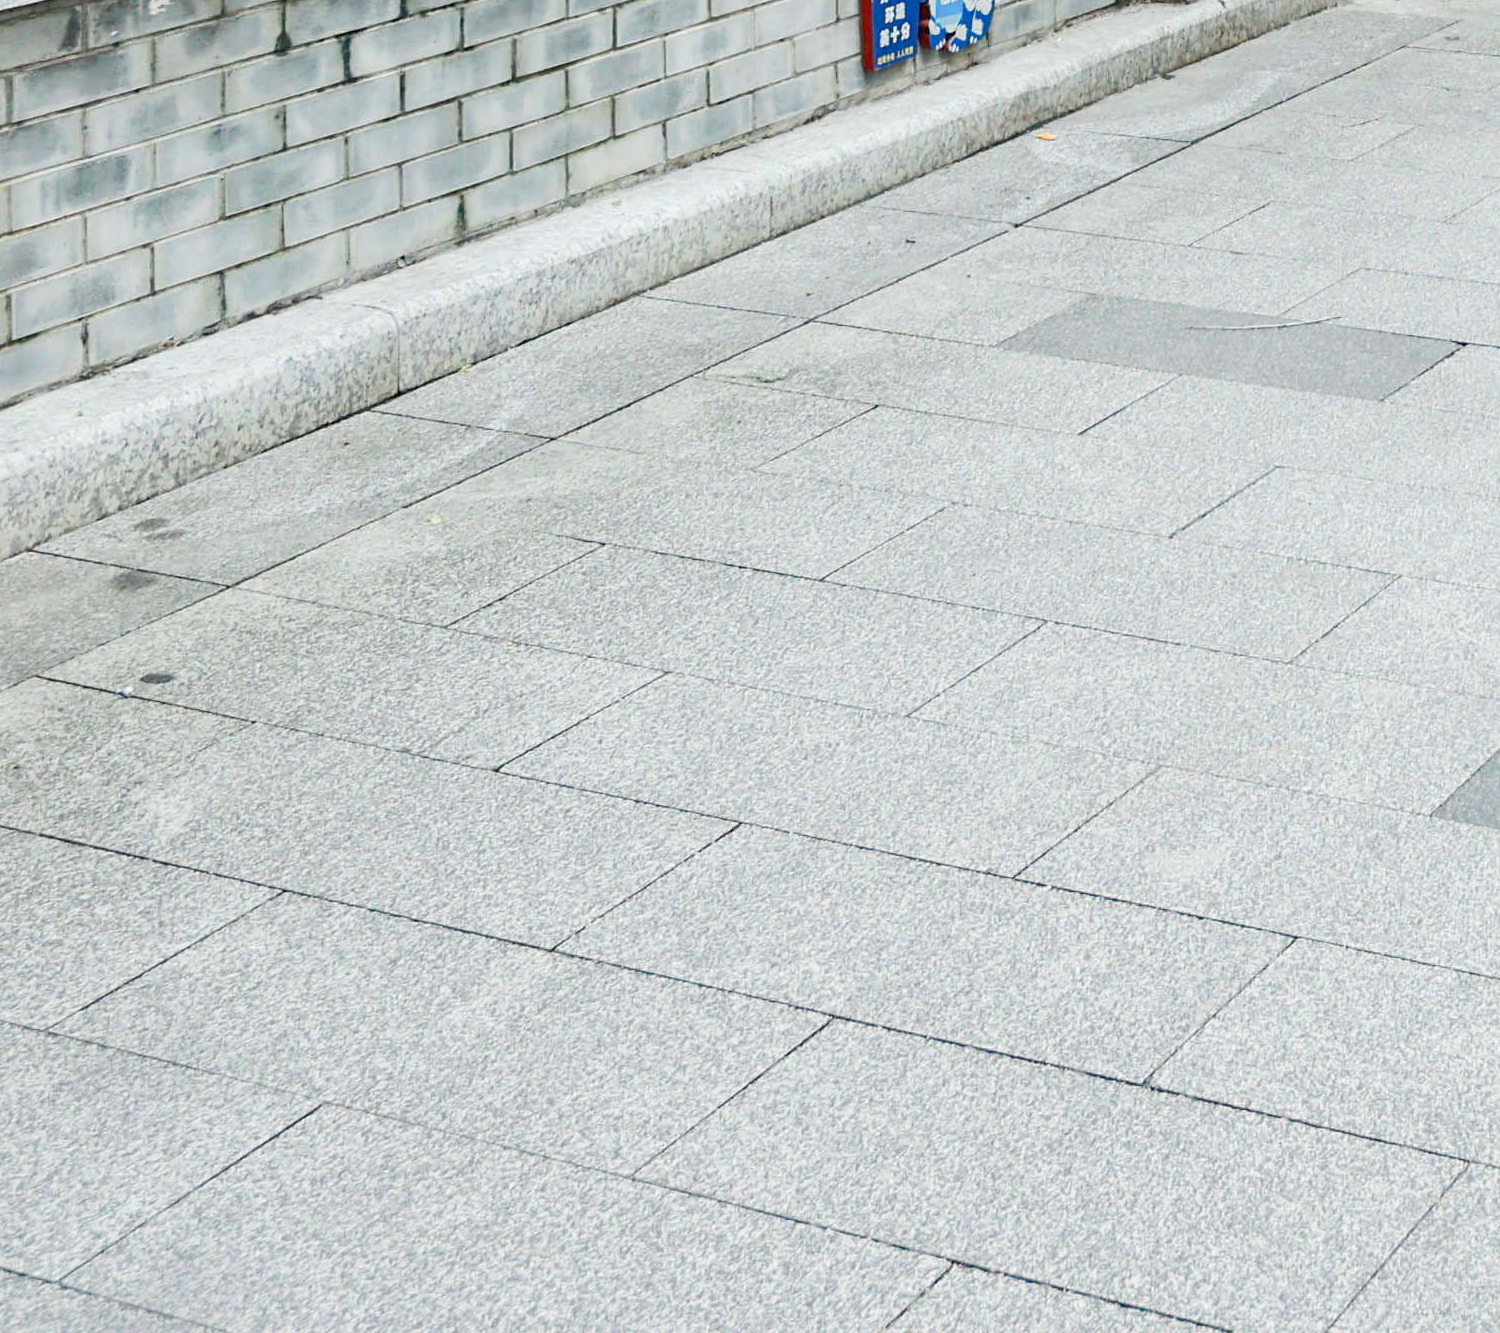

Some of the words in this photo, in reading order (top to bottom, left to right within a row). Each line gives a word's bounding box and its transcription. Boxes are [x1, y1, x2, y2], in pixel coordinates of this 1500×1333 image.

[885, 2, 906, 24] 环境
[880, 22, 911, 48] 美十分
